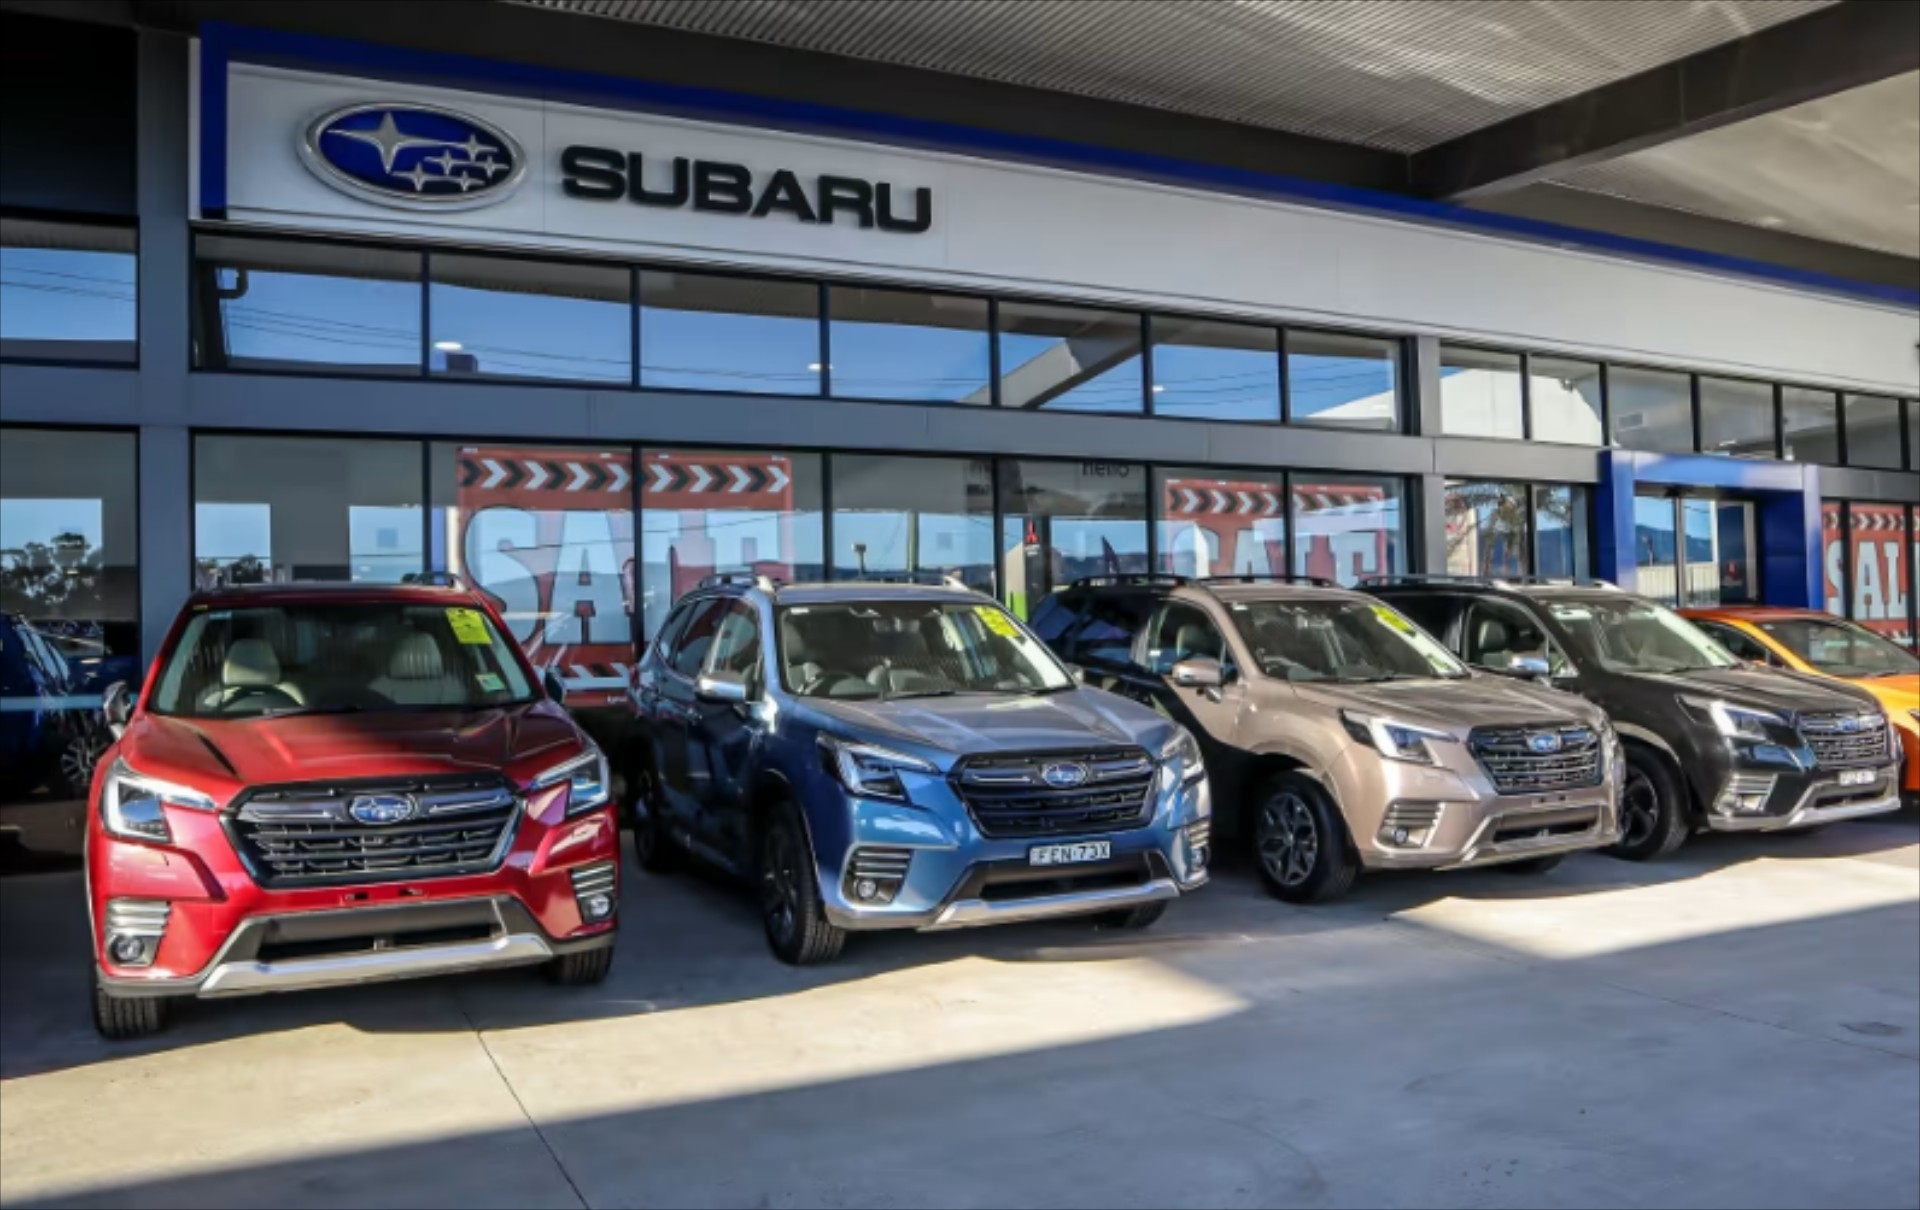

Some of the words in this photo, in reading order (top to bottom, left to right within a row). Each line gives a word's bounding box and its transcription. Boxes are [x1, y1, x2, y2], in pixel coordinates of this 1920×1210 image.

[560, 144, 931, 234] SUBARU
[1082, 462, 1129, 478] helo
[1827, 539, 1920, 620] SAL
